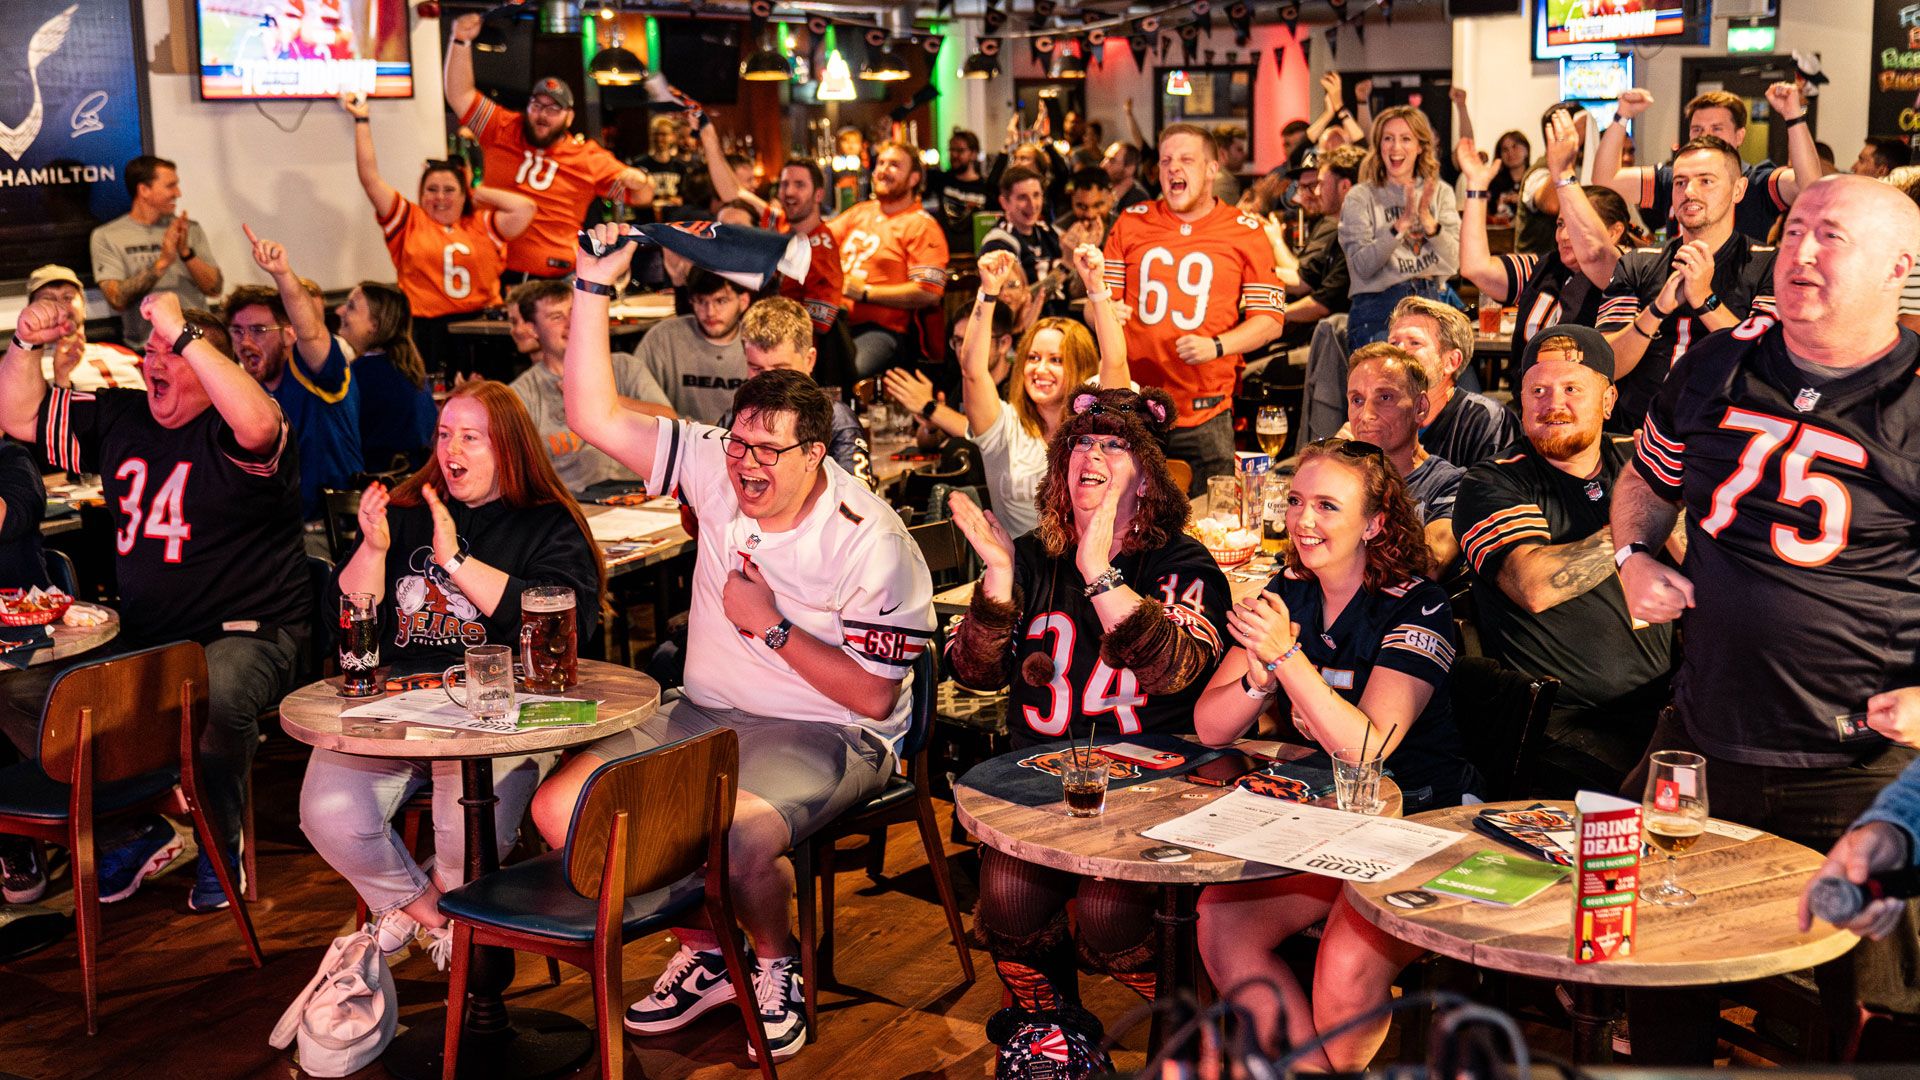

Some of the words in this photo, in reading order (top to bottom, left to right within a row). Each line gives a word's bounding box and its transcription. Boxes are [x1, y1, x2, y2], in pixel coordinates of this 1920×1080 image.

[0, 165, 115, 187] HAMILTON
[515, 150, 559, 191] 10
[444, 242, 471, 299] 6
[840, 229, 880, 279] 52
[1138, 246, 1213, 330] 69
[683, 375, 748, 390] BEAR
[1700, 405, 1867, 568] 75
[115, 457, 192, 563] 34
[1157, 573, 1205, 614] 34
[395, 607, 487, 648] BEARS
[413, 637, 457, 646] CHICAGO
[865, 629, 906, 660] GSH
[1404, 630, 1438, 654] GSH
[1022, 610, 1148, 737] 34
[1583, 817, 1640, 838] DRINK
[1583, 835, 1640, 856] DEALS
[1306, 858, 1380, 880] FOOD
